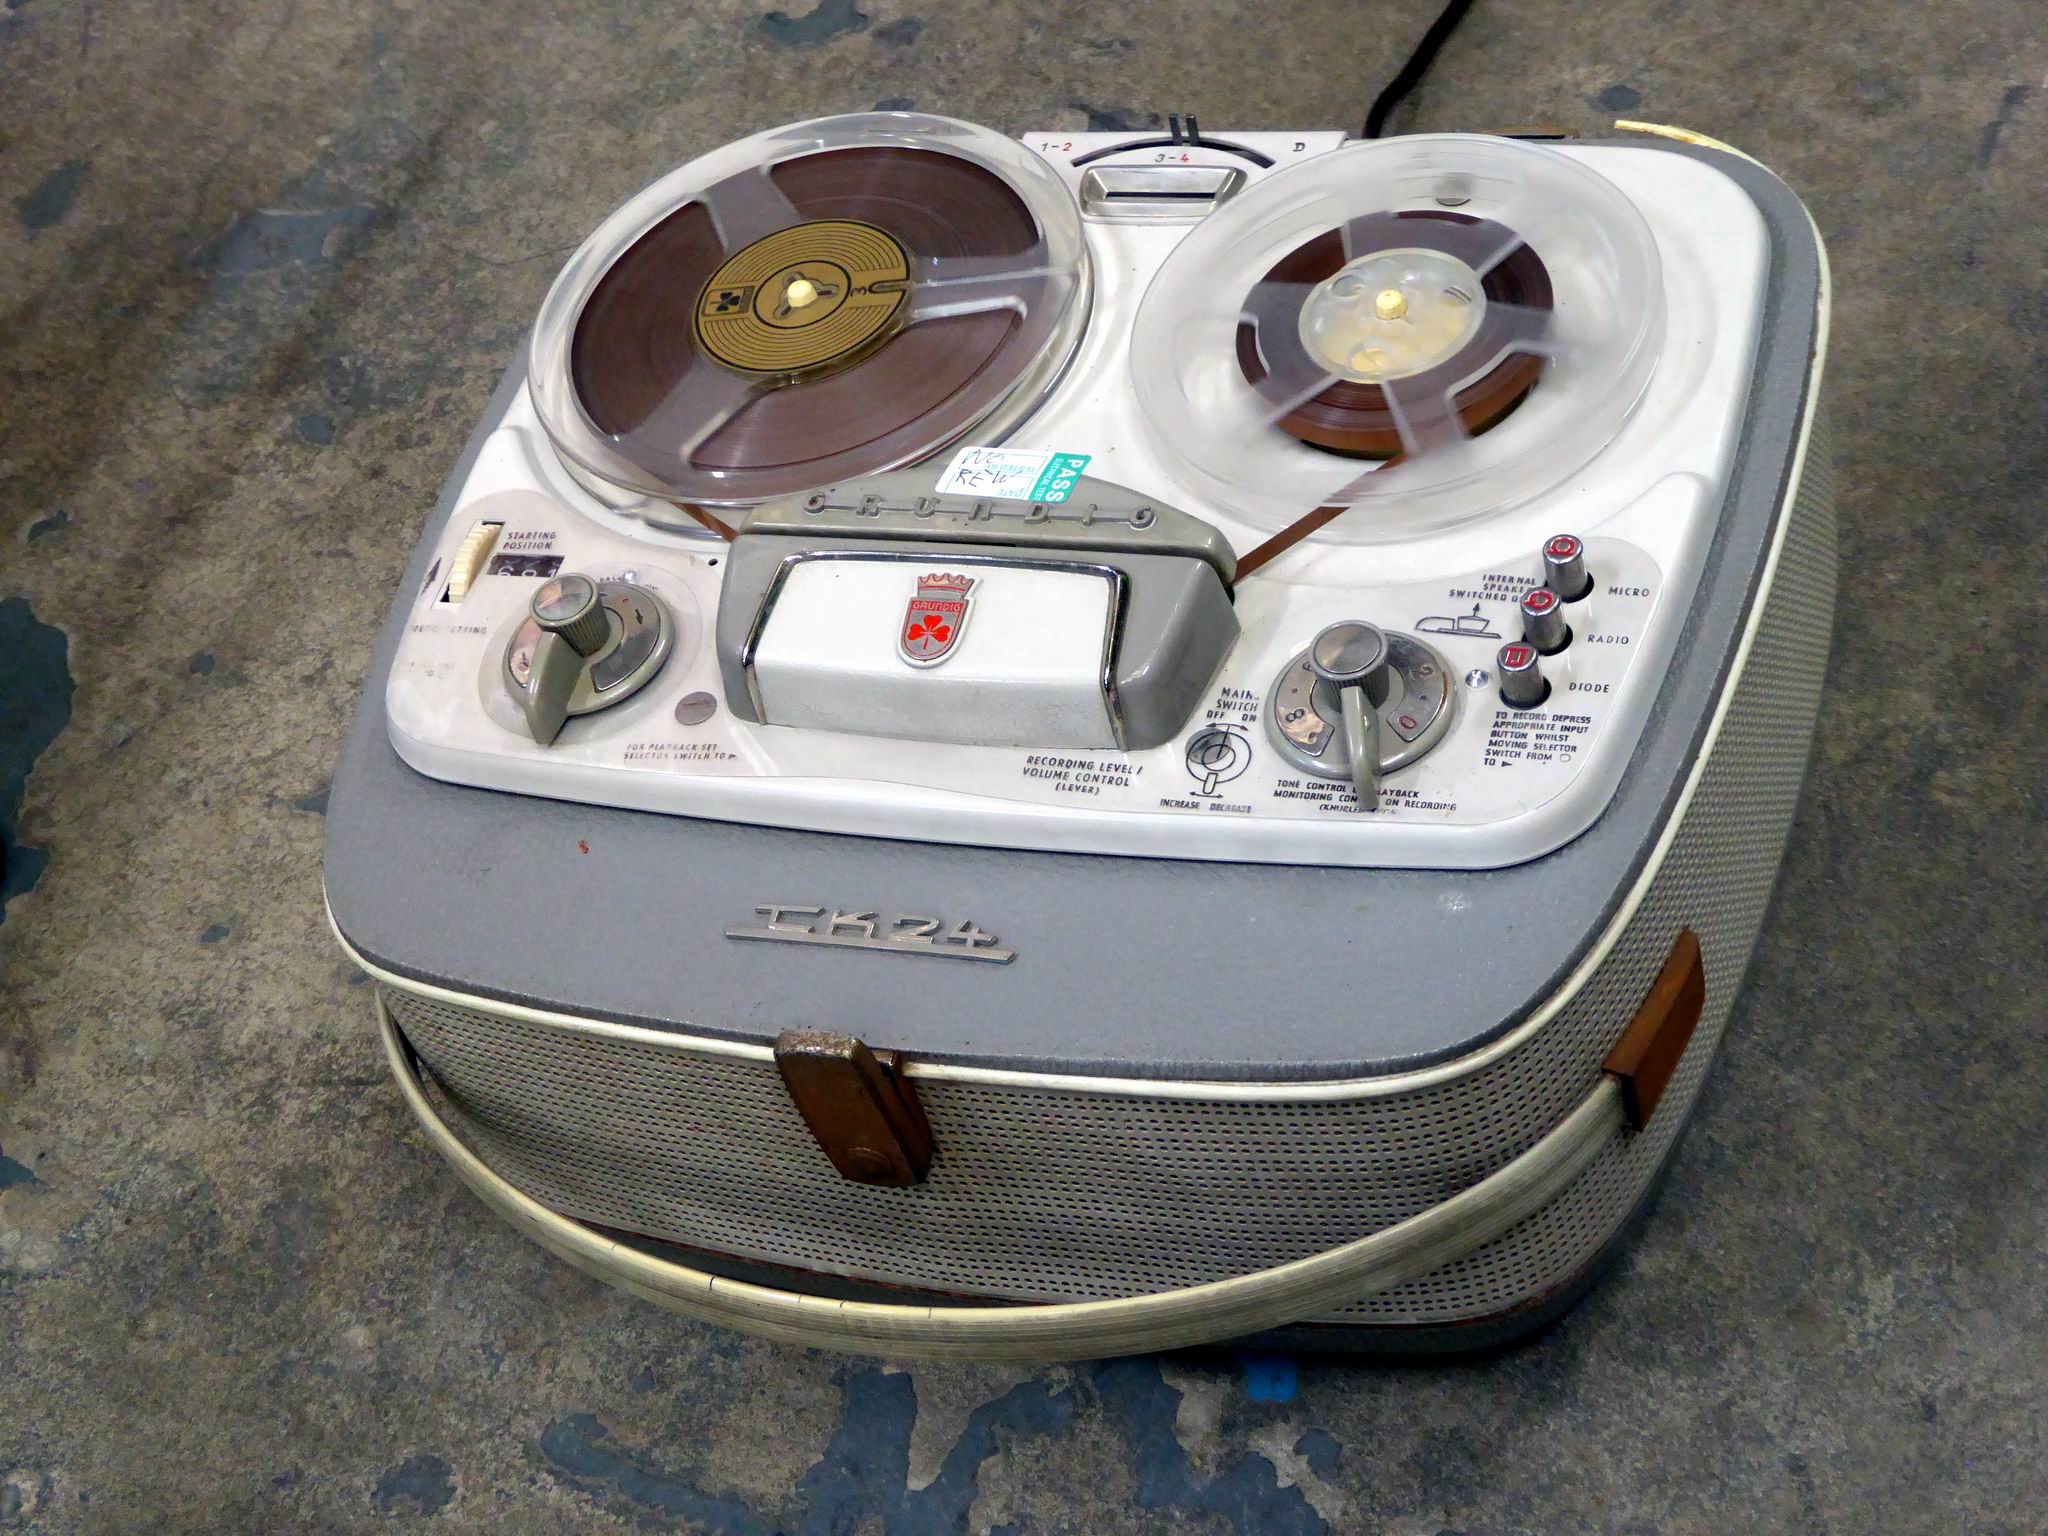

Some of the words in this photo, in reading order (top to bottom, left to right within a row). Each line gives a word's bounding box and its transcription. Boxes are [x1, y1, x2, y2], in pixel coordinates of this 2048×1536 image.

[1293, 142, 1306, 152] D
[1045, 458, 1084, 502] PASS
[803, 491, 1158, 532] GRUNDIG
[508, 531, 556, 540] STARTING
[502, 541, 552, 550] POSITION
[1482, 574, 1536, 586] INTERNAL
[1449, 589, 1508, 601] SWITCHED
[1608, 586, 1650, 597] MICRO
[912, 601, 961, 612] GRUNDIG
[1587, 634, 1630, 645] RADIO
[1221, 687, 1253, 700] MAIN
[1568, 682, 1610, 693] DIODE
[1216, 699, 1258, 711] SWITCH
[1206, 710, 1225, 719] OFF
[1241, 713, 1257, 722] ON
[1495, 711, 1508, 720] TO
[1513, 712, 1547, 721] RECORD
[1552, 714, 1592, 724] DEPRESS
[1492, 721, 1556, 731] APPROPRIATE
[1560, 725, 1589, 734] INPUT
[1490, 730, 1528, 739] BUTTON
[1535, 733, 1569, 742] WHILST
[1488, 739, 1528, 749] MOVING
[1533, 743, 1577, 753] SELECTOR
[1485, 748, 1521, 758] SWITCH
[1526, 752, 1552, 761] FROM
[1026, 755, 1095, 770] RECORDING
[1484, 757, 1496, 766] TO
[1022, 767, 1069, 780] VOLUME
[1075, 772, 1130, 787] CONTROL
[1055, 782, 1100, 795] (LEVER)
[1277, 779, 1300, 788] TONE
[1306, 782, 1346, 792] CONTROL
[1273, 790, 1332, 801] MONITORING
[1385, 798, 1400, 807] ON
[1160, 798, 1201, 809] INCREASE
[1209, 802, 1252, 813] DECREASE
